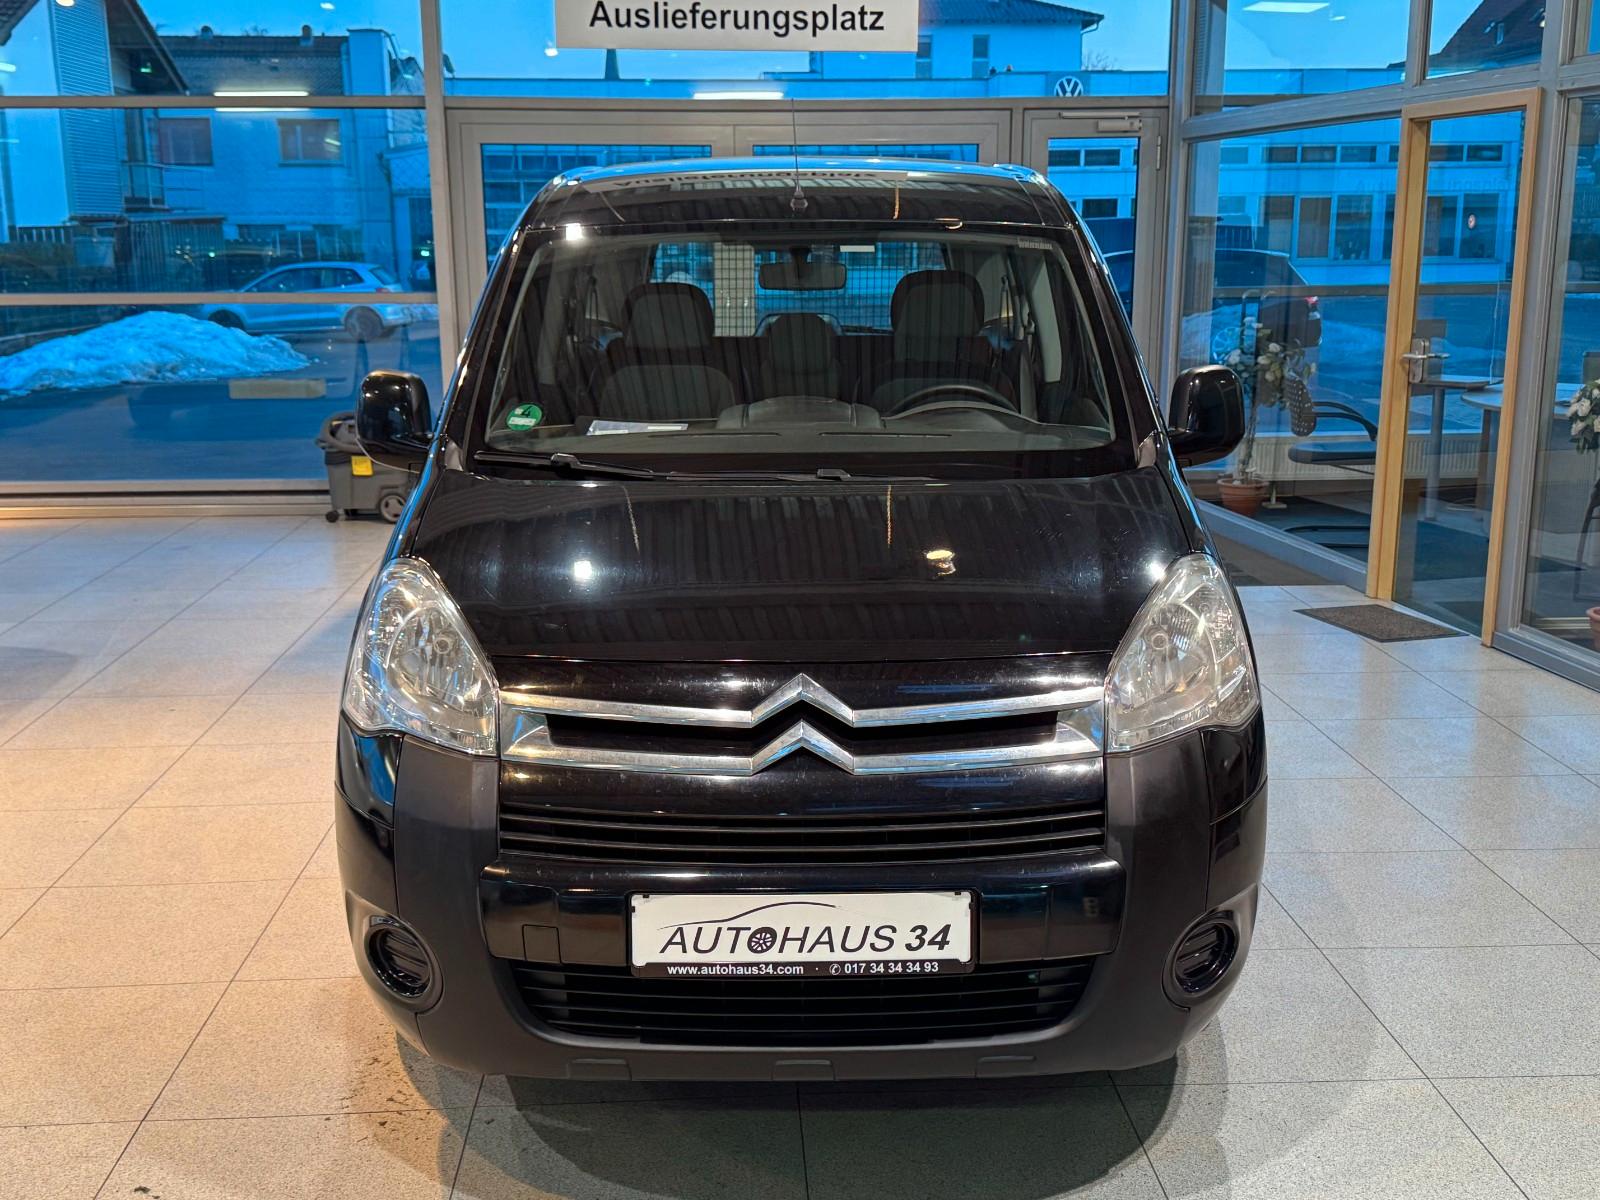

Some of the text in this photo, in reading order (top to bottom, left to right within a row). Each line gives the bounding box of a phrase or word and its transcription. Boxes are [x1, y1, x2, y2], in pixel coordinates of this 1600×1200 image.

[589, 0, 885, 37] Auslieferungsplatz
[659, 923, 951, 954] AUTOHAUS 34
[667, 961, 939, 976] www.autohaus34.com 017 34 34 34 93
